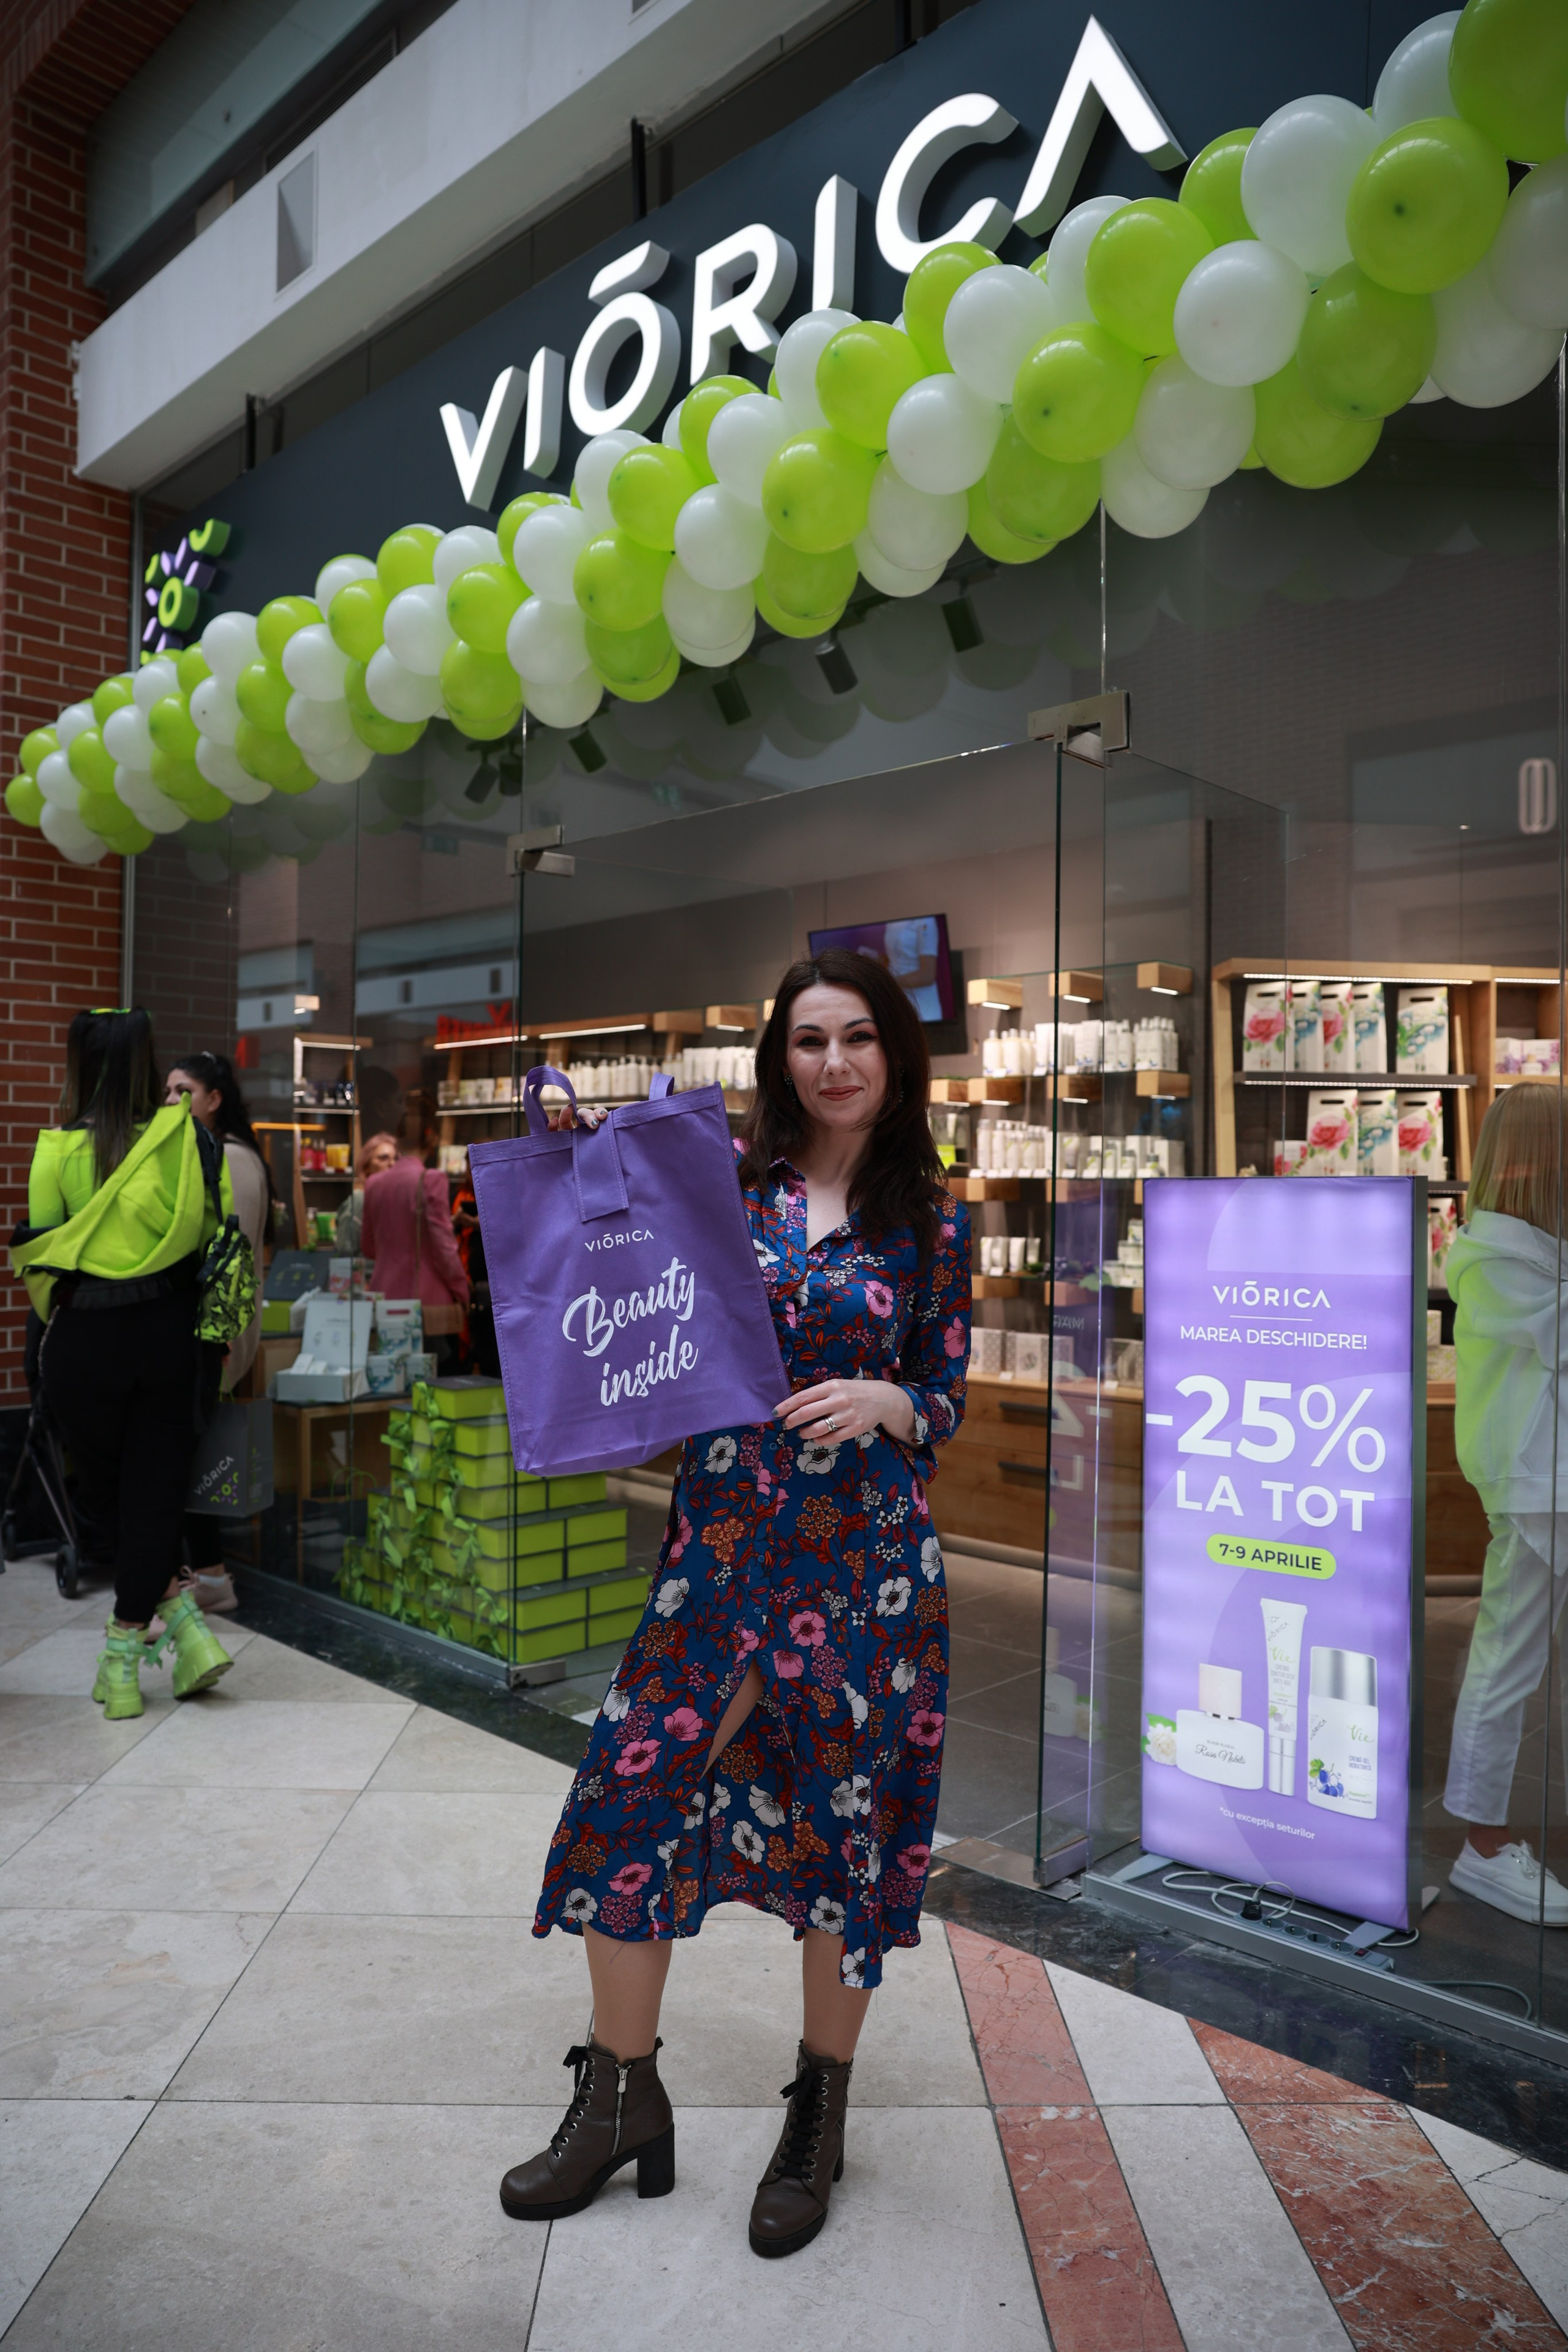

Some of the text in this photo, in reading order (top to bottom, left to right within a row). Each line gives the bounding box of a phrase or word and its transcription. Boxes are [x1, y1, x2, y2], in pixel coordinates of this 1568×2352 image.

[562, 1257, 695, 1357] Beauty
[1180, 1324, 1368, 1350] MAREA DESCHIDERE!
[599, 1324, 699, 1406] inside
[1146, 1374, 1386, 1474] -25%
[1177, 1469, 1375, 1532] LA TOT
[1218, 1542, 1322, 1572] 7-9 APRILIE
[1347, 1724, 1375, 1744] Vie
[1276, 1823, 1316, 1840] seturilor
